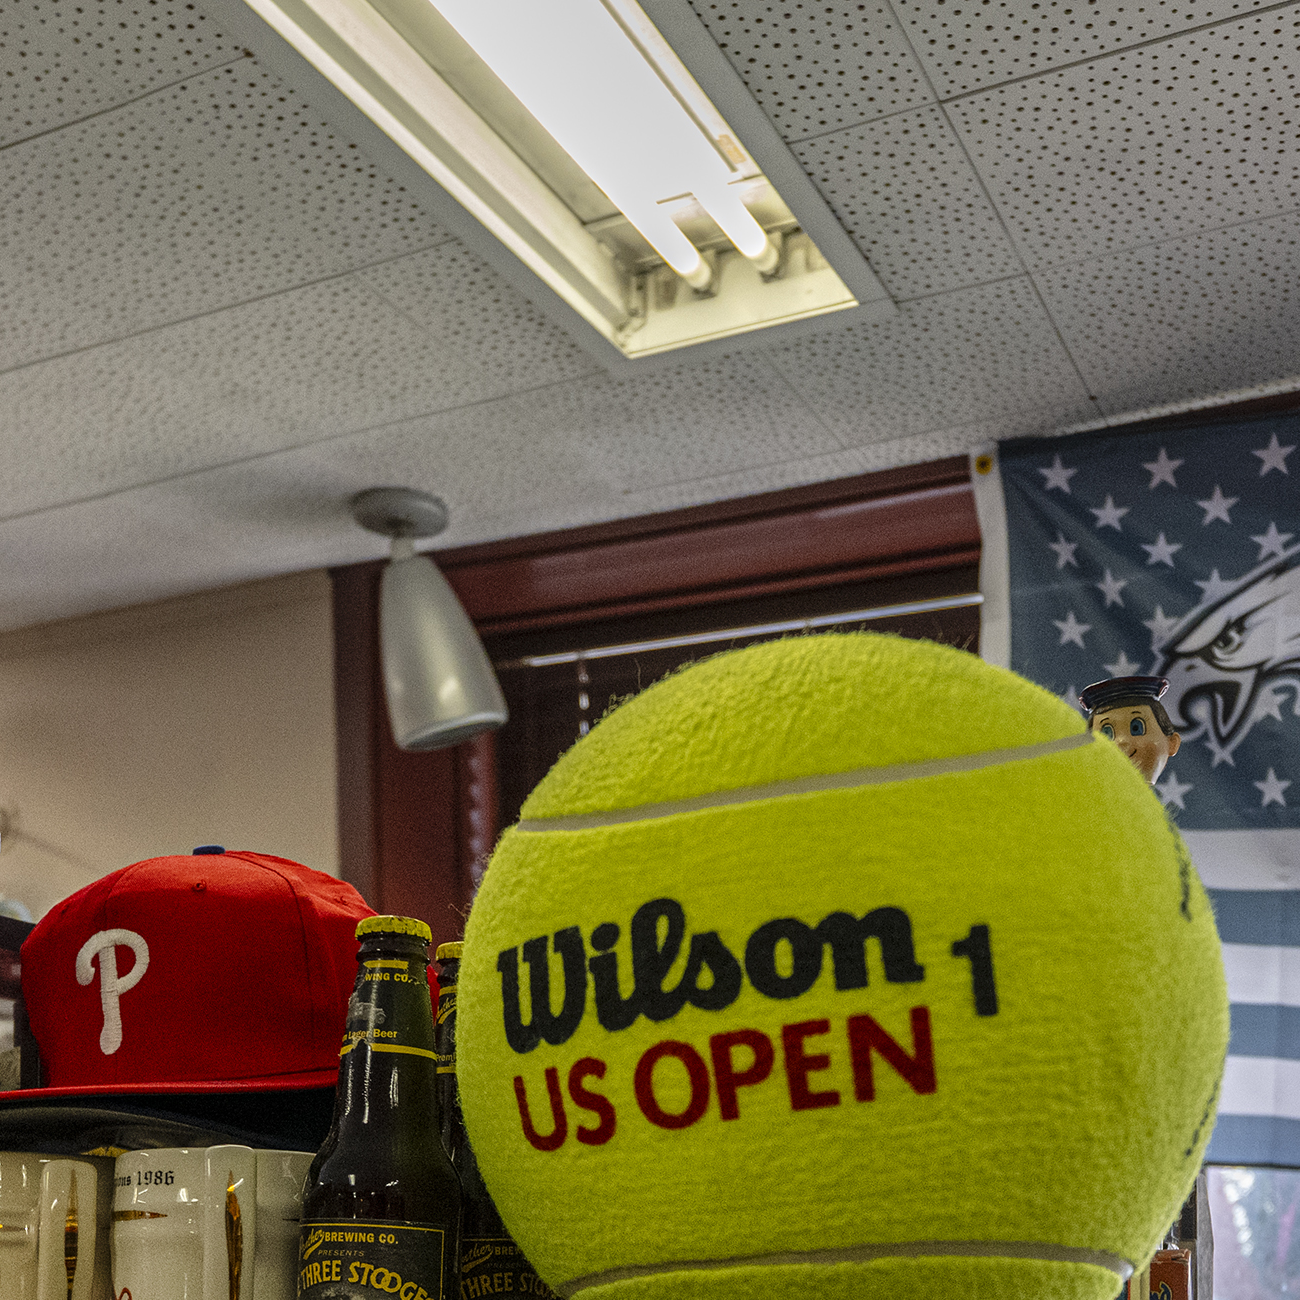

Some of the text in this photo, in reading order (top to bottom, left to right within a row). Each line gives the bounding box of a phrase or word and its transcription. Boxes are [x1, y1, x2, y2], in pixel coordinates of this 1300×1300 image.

[497, 898, 1001, 1054] Wilson 1
[75, 928, 151, 1056] P
[373, 1029, 398, 1038] Beer
[513, 1006, 939, 1153] US OPEN
[137, 1171, 174, 1186] 1986
[325, 1231, 399, 1245] BREWING CO.
[318, 1249, 365, 1257] PRESENTS
[301, 1260, 341, 1290] THREE
